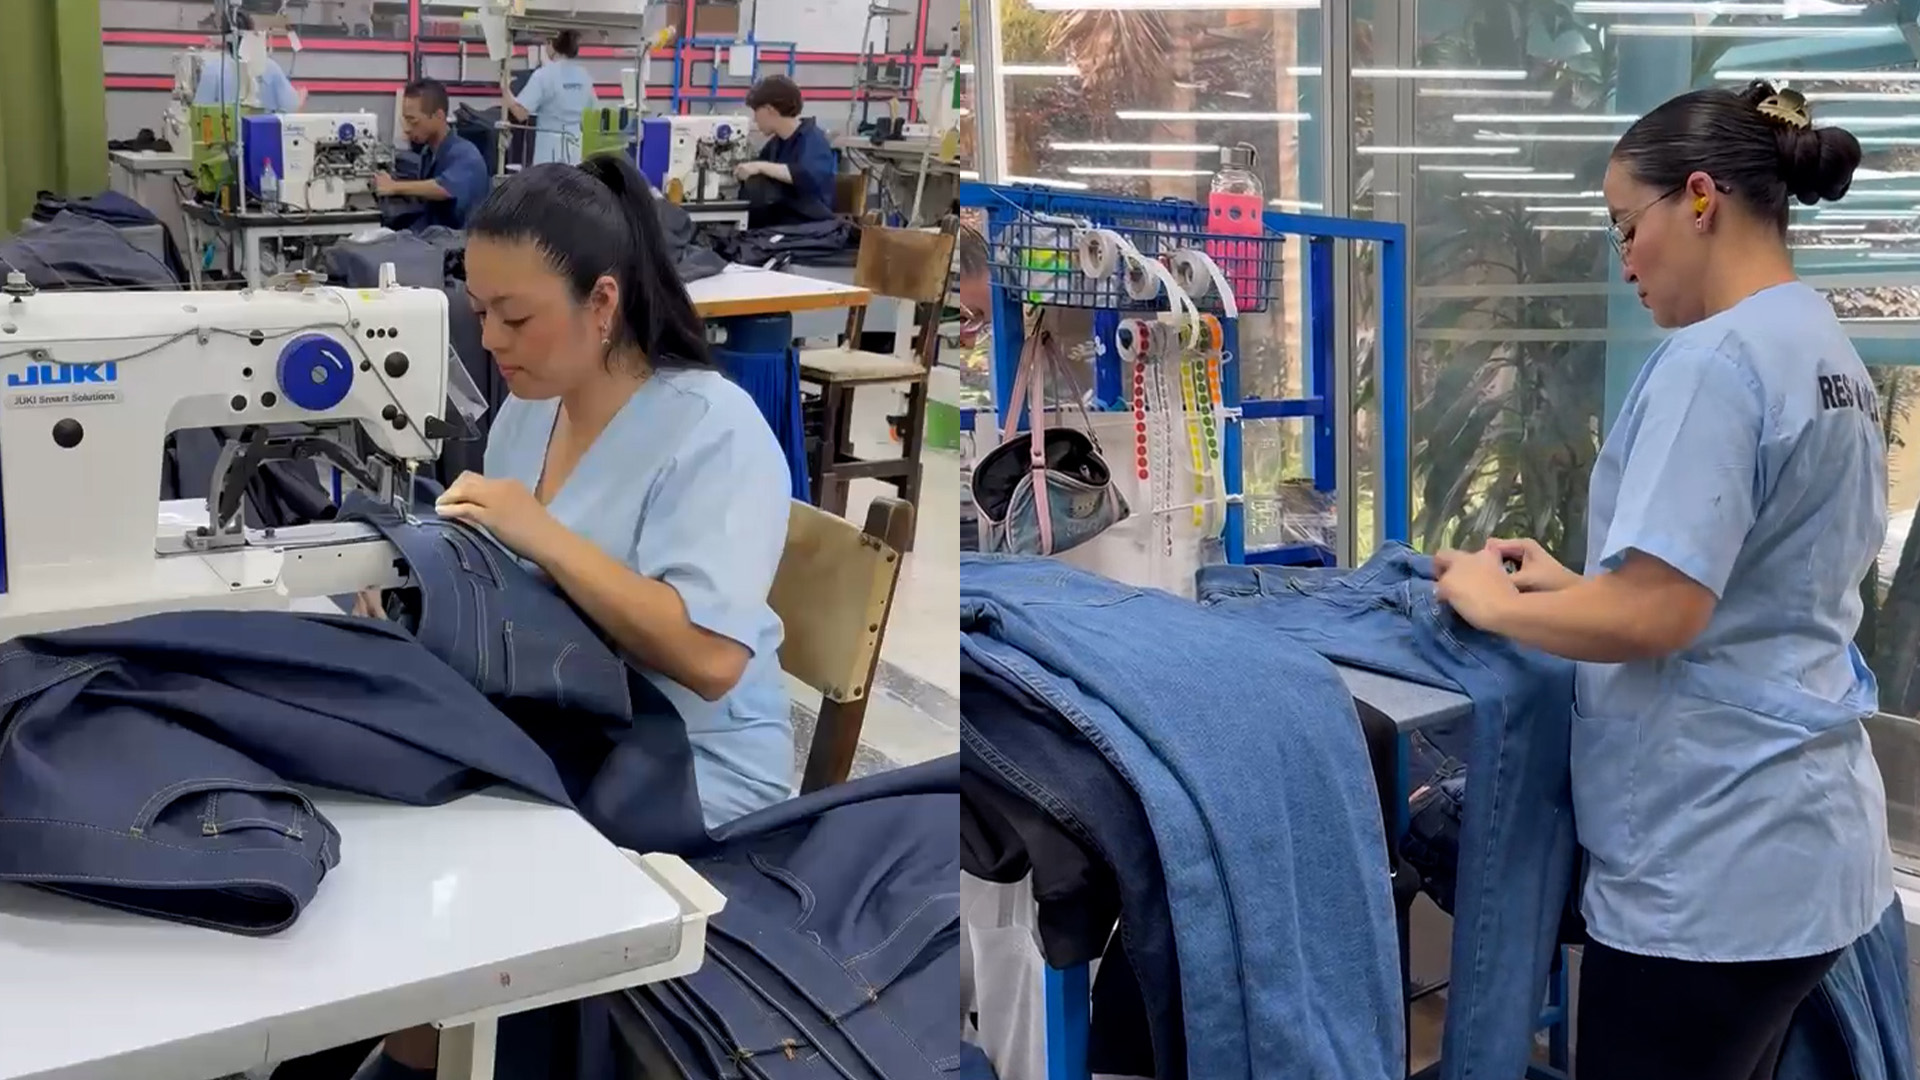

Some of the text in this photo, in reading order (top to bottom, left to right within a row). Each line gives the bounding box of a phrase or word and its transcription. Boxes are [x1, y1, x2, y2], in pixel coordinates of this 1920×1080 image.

[7, 361, 118, 386] JUKI
[14, 391, 116, 405] JUKI Smart Solutions
